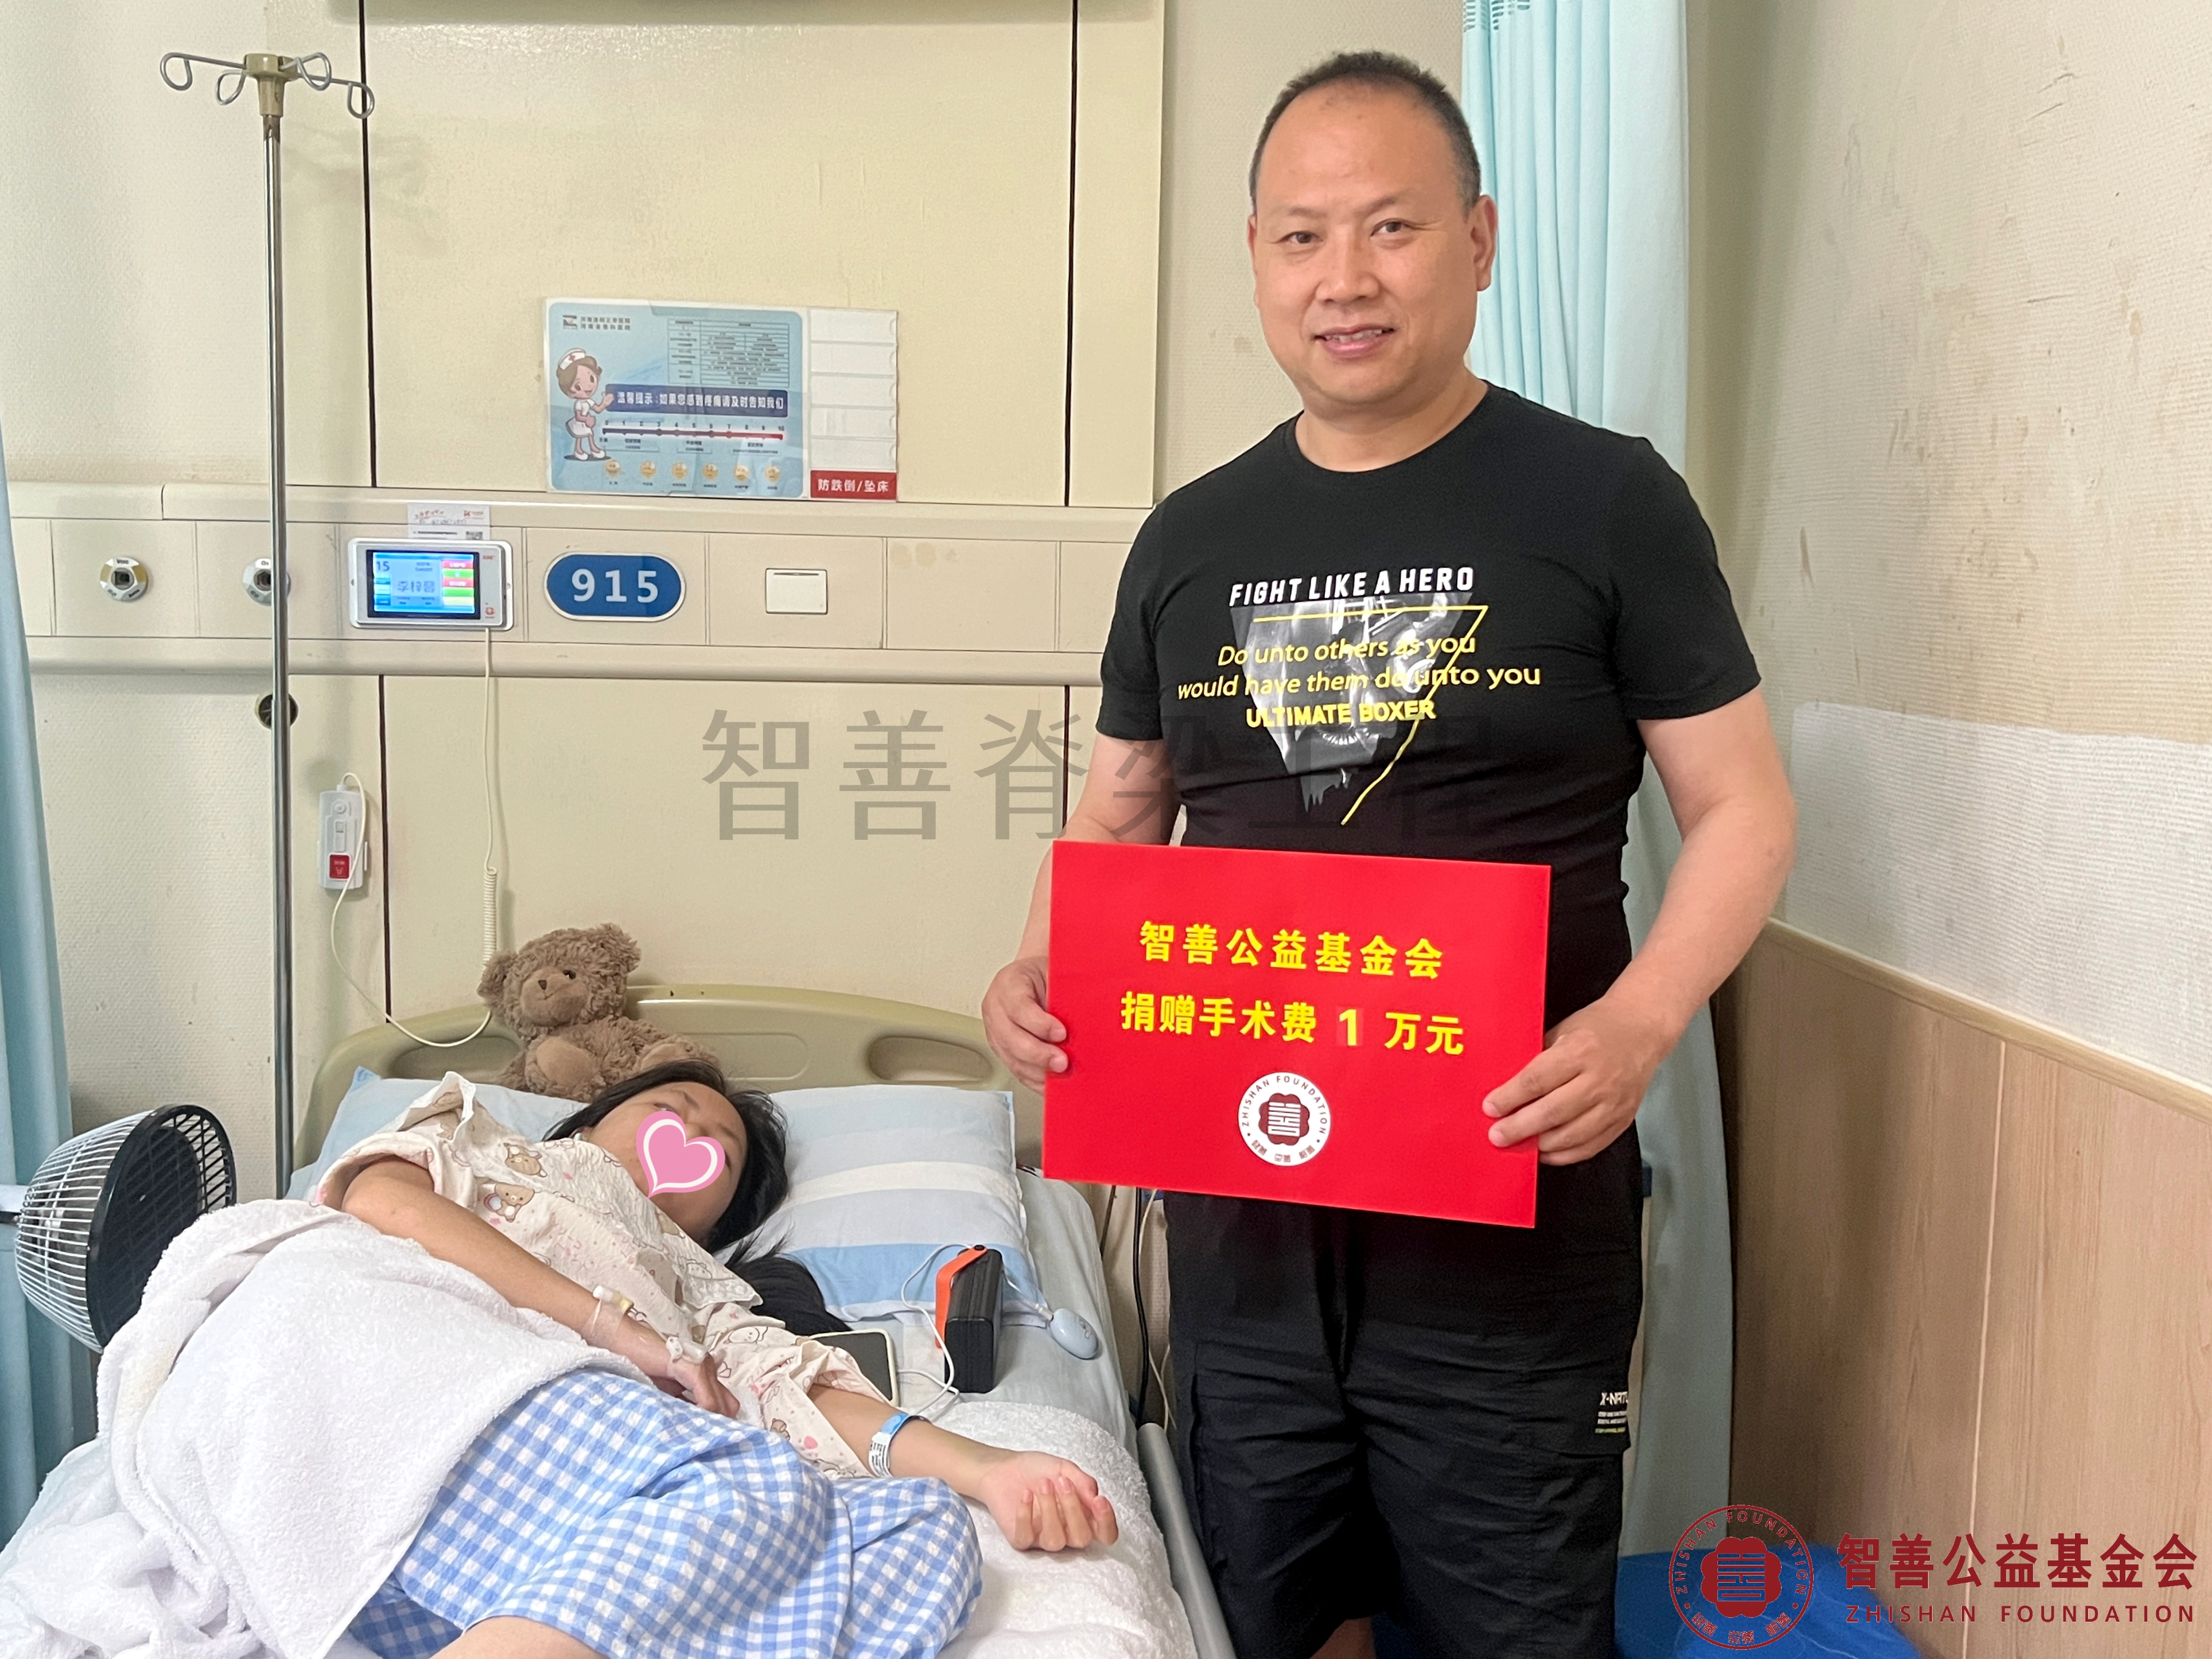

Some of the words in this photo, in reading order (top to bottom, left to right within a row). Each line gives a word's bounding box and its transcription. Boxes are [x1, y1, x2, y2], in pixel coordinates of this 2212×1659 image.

[376, 561, 390, 571] 15
[572, 568, 659, 603] 915
[1229, 578, 1302, 606] FIGHT
[1309, 573, 1367, 599] LIKE
[1374, 571, 1390, 594] A
[1399, 567, 1474, 593] HERO
[1218, 645, 1248, 666] Do
[1254, 643, 1309, 664] unto
[1314, 637, 1388, 661] others
[1394, 638, 1420, 655] as
[1426, 637, 1476, 659] you
[1177, 675, 1238, 700] would
[1245, 675, 1301, 696] have
[1306, 671, 1369, 691] them
[1374, 667, 1406, 688] do
[1413, 665, 1480, 687] unto
[1487, 667, 1541, 691] you
[1245, 703, 1351, 728] ULTIMATE
[1358, 700, 1437, 722] BOXER
[1140, 920, 1443, 979] 智善公益基金会
[1121, 991, 1317, 1043] 捐赠手术费
[1339, 1009, 1358, 1046] 1
[1385, 1012, 1465, 1056] 万元
[1241, 1079, 1270, 1127] ZHISHAN
[1276, 1075, 1328, 1135] FOUNDATION
